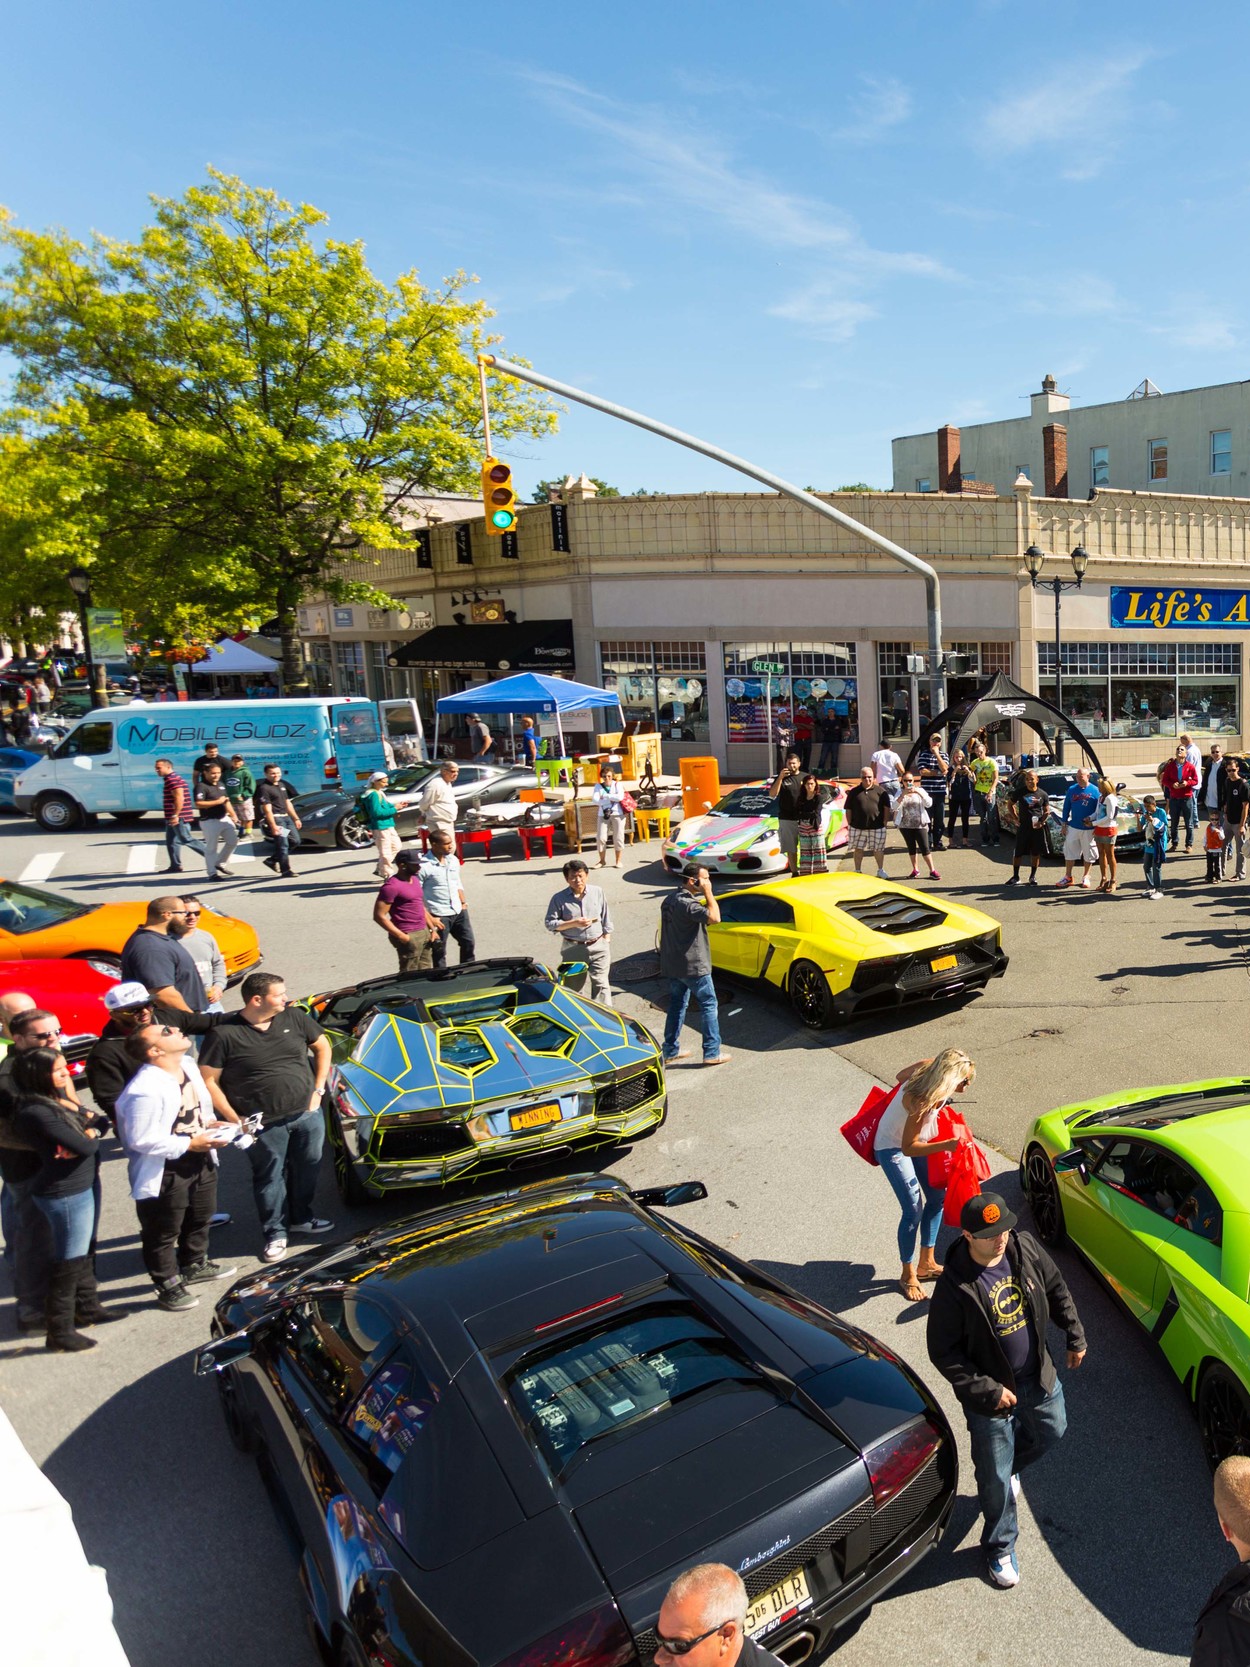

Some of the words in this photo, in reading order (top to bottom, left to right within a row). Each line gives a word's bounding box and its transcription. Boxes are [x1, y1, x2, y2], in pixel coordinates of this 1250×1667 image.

[554, 505, 564, 551] martinis
[1123, 590, 1213, 628] Life's
[754, 661, 775, 673] GLEN
[518, 1107, 555, 1125] WINNING
[736, 1534, 791, 1573] Lamborghini
[770, 1577, 804, 1613] DLR
[750, 1626, 767, 1641] BEST
[767, 1616, 782, 1632] BUY
